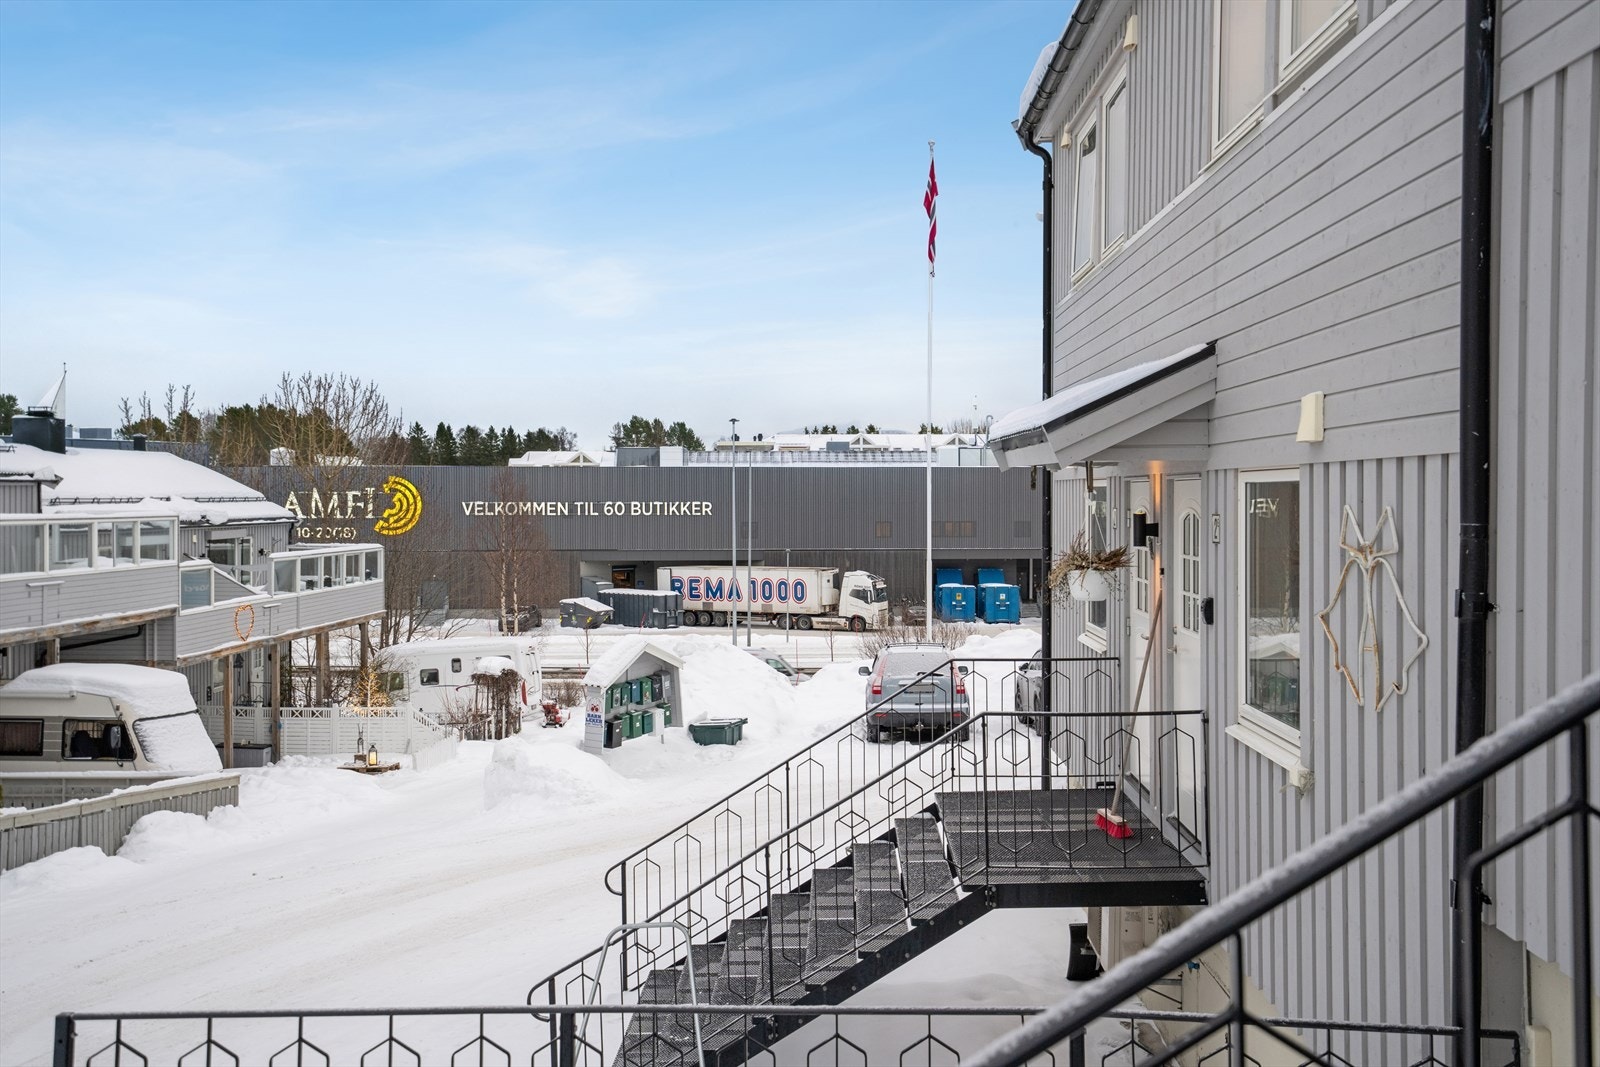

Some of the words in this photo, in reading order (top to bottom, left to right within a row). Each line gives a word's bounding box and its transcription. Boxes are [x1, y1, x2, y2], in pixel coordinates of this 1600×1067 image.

[284, 487, 376, 519] AMFI
[461, 501, 569, 516] VELKOMMEN
[574, 501, 599, 516] TIL
[603, 501, 626, 516] 60
[630, 501, 713, 516] BUTIKKER
[671, 576, 743, 602] REMA
[750, 577, 807, 604] 1000
